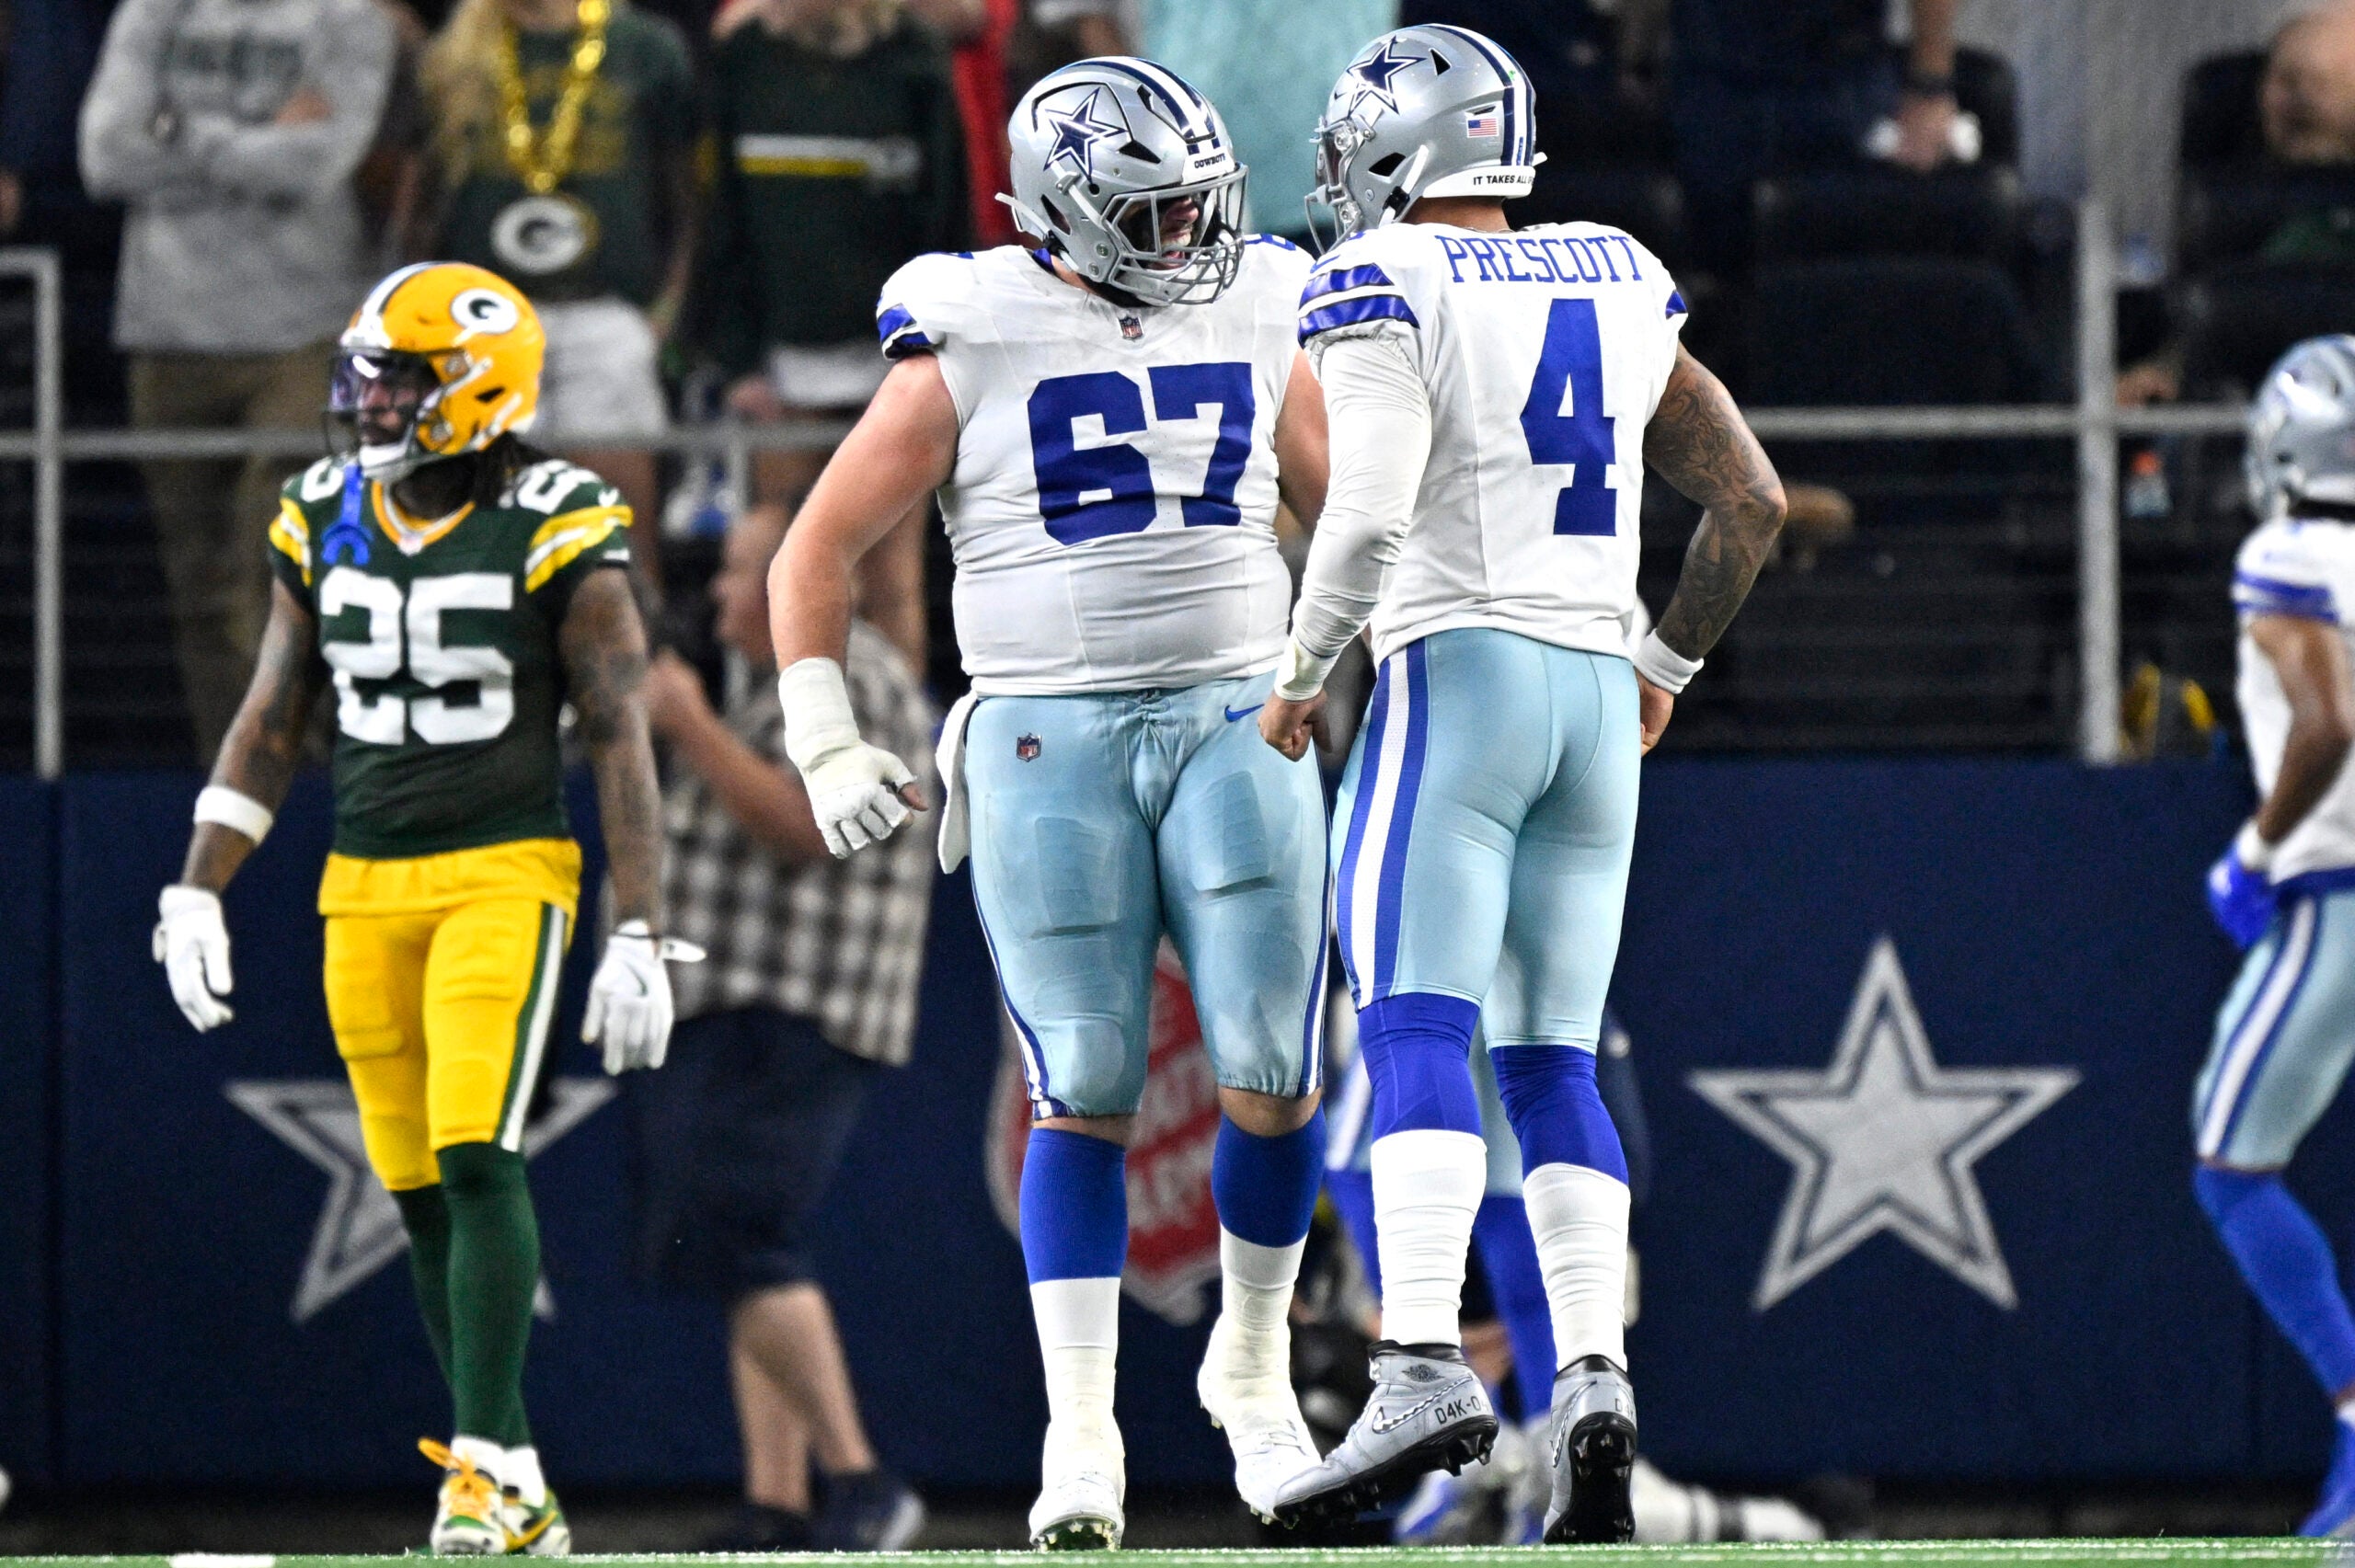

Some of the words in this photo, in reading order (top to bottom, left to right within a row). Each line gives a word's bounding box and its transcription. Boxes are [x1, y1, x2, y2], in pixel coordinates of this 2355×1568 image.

[1434, 235, 1643, 283] PRESCOTT
[1474, 177, 1483, 185] IT
[1487, 175, 1515, 184] TAKES
[1027, 361, 1256, 546] 67
[1519, 298, 1617, 537] 4
[320, 566, 515, 746] 25
